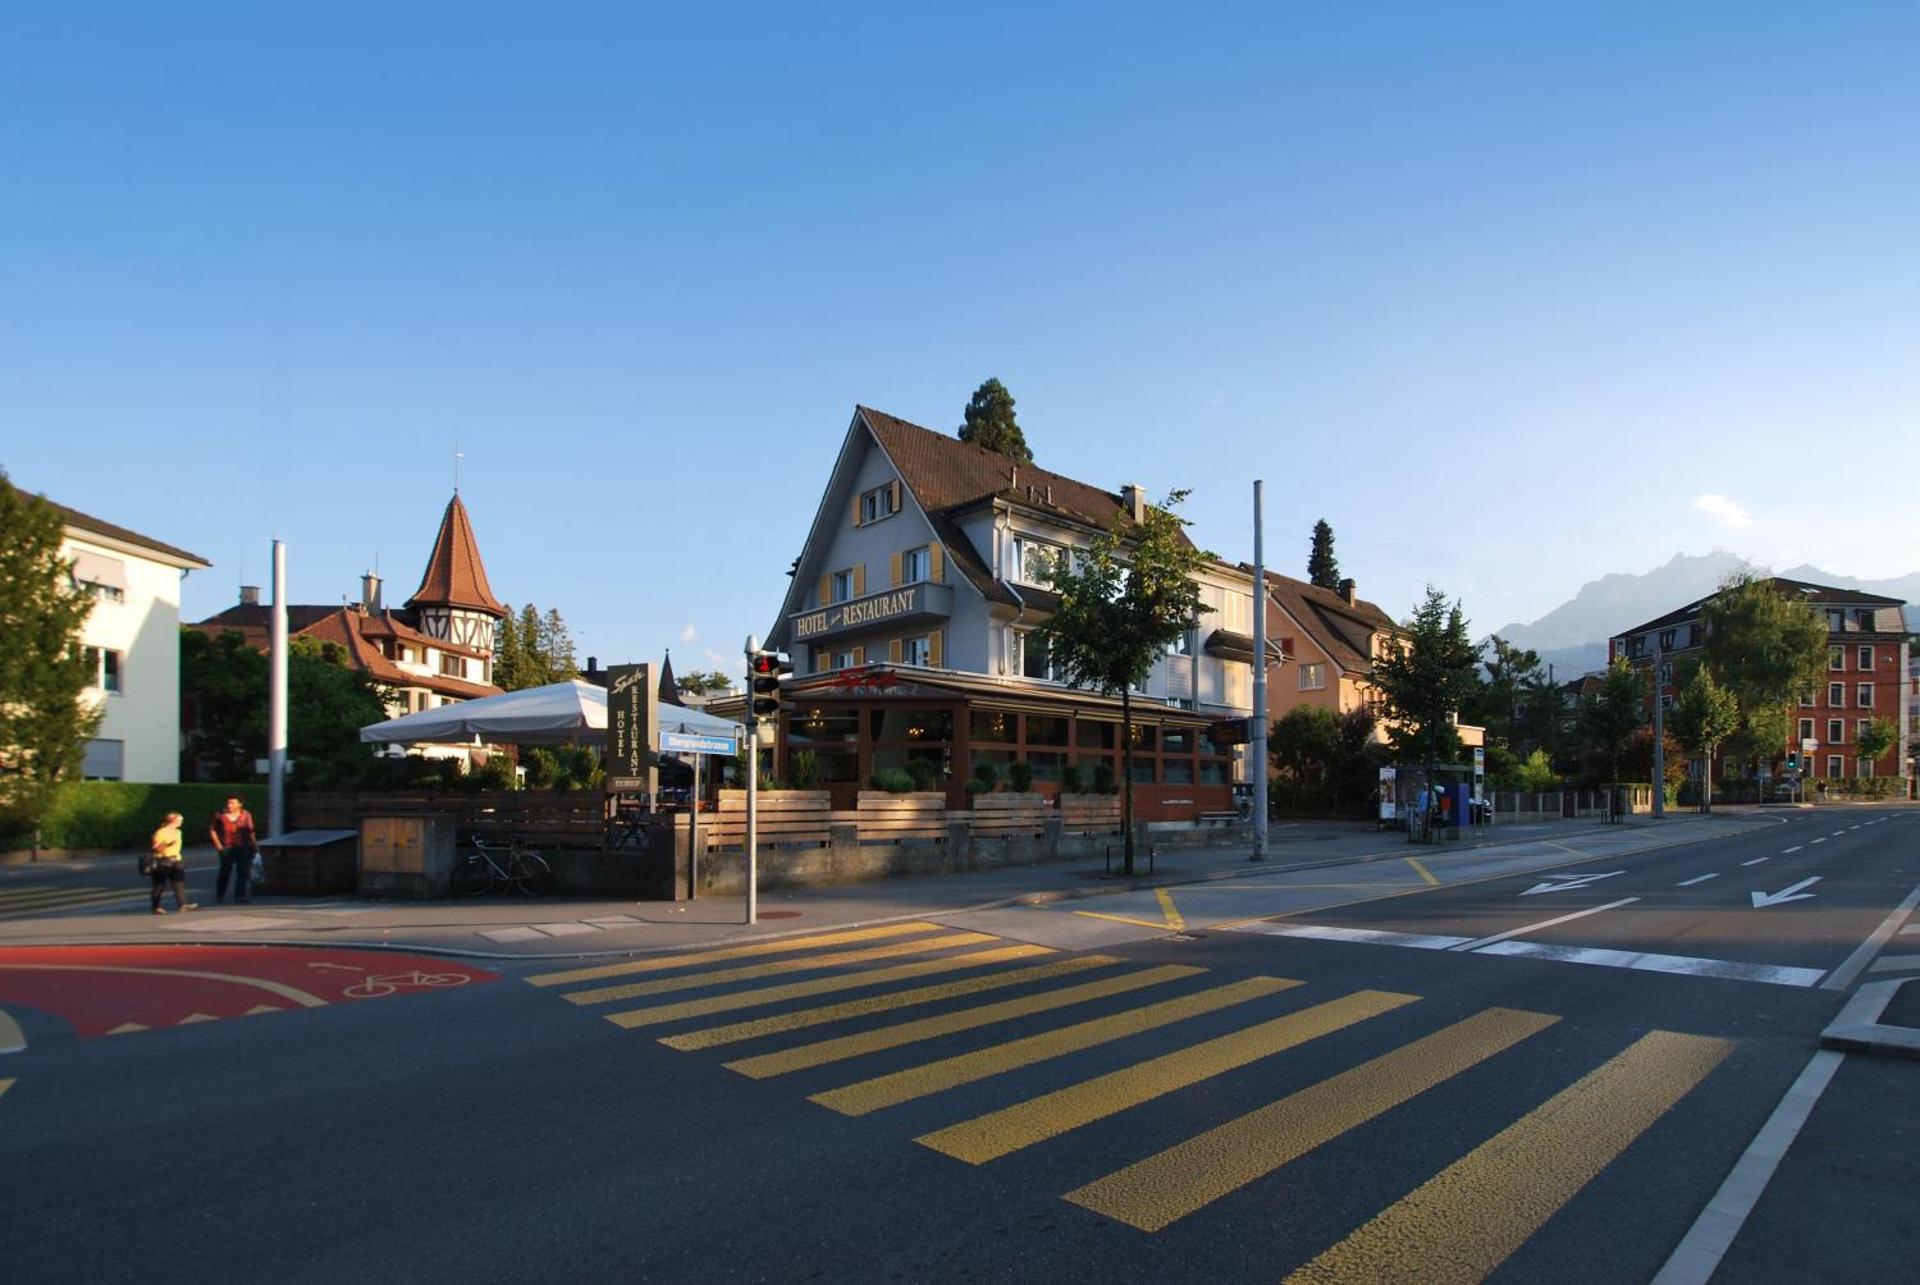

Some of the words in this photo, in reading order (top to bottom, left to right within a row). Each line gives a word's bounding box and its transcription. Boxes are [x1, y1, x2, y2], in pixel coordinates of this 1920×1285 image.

[798, 612, 829, 637] HOTEL
[842, 589, 915, 626] RESTAURANT
[617, 710, 625, 758] HOTEL
[630, 685, 639, 776] RESTAURANT
